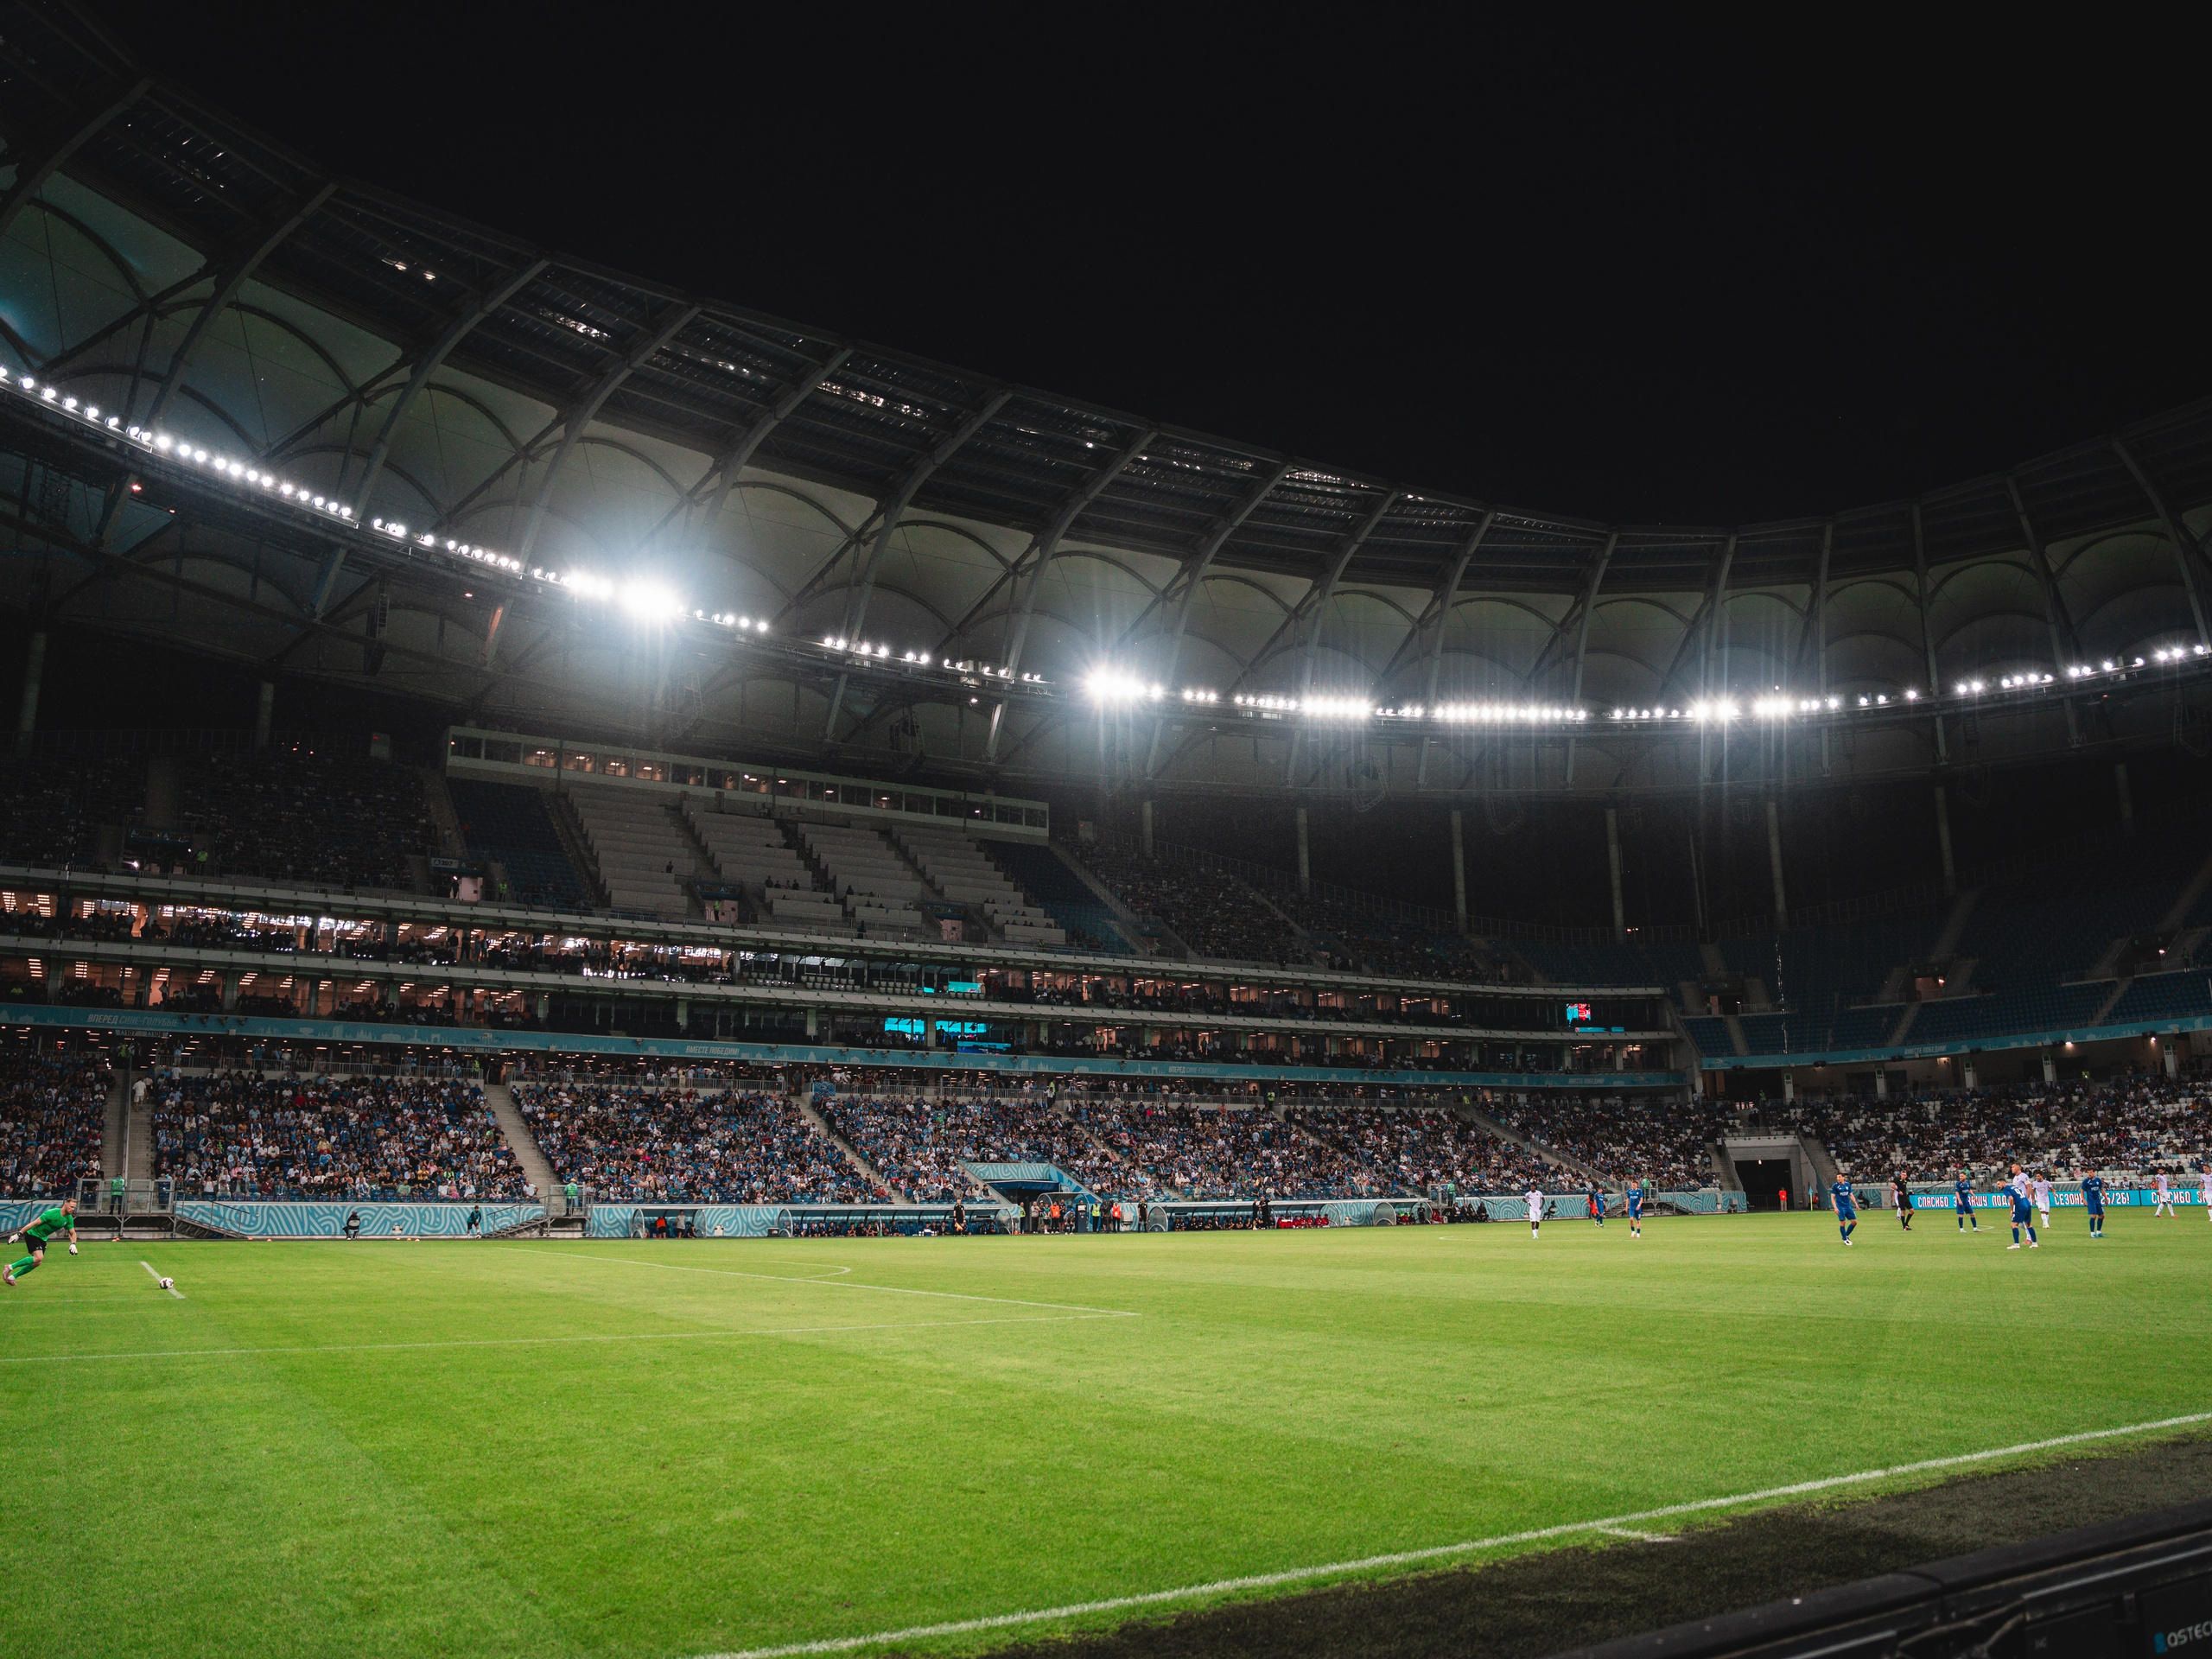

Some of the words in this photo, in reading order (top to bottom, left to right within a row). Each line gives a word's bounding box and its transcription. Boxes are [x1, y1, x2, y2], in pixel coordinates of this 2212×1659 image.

[87, 1014, 118, 1025] ВПЕРЕД
[119, 1015, 178, 1027] СИНЕ-ГОЛУБЫЕ
[685, 1046, 709, 1054] ВМЕСТЕ
[1917, 1197, 1948, 1208] СПАСИБО
